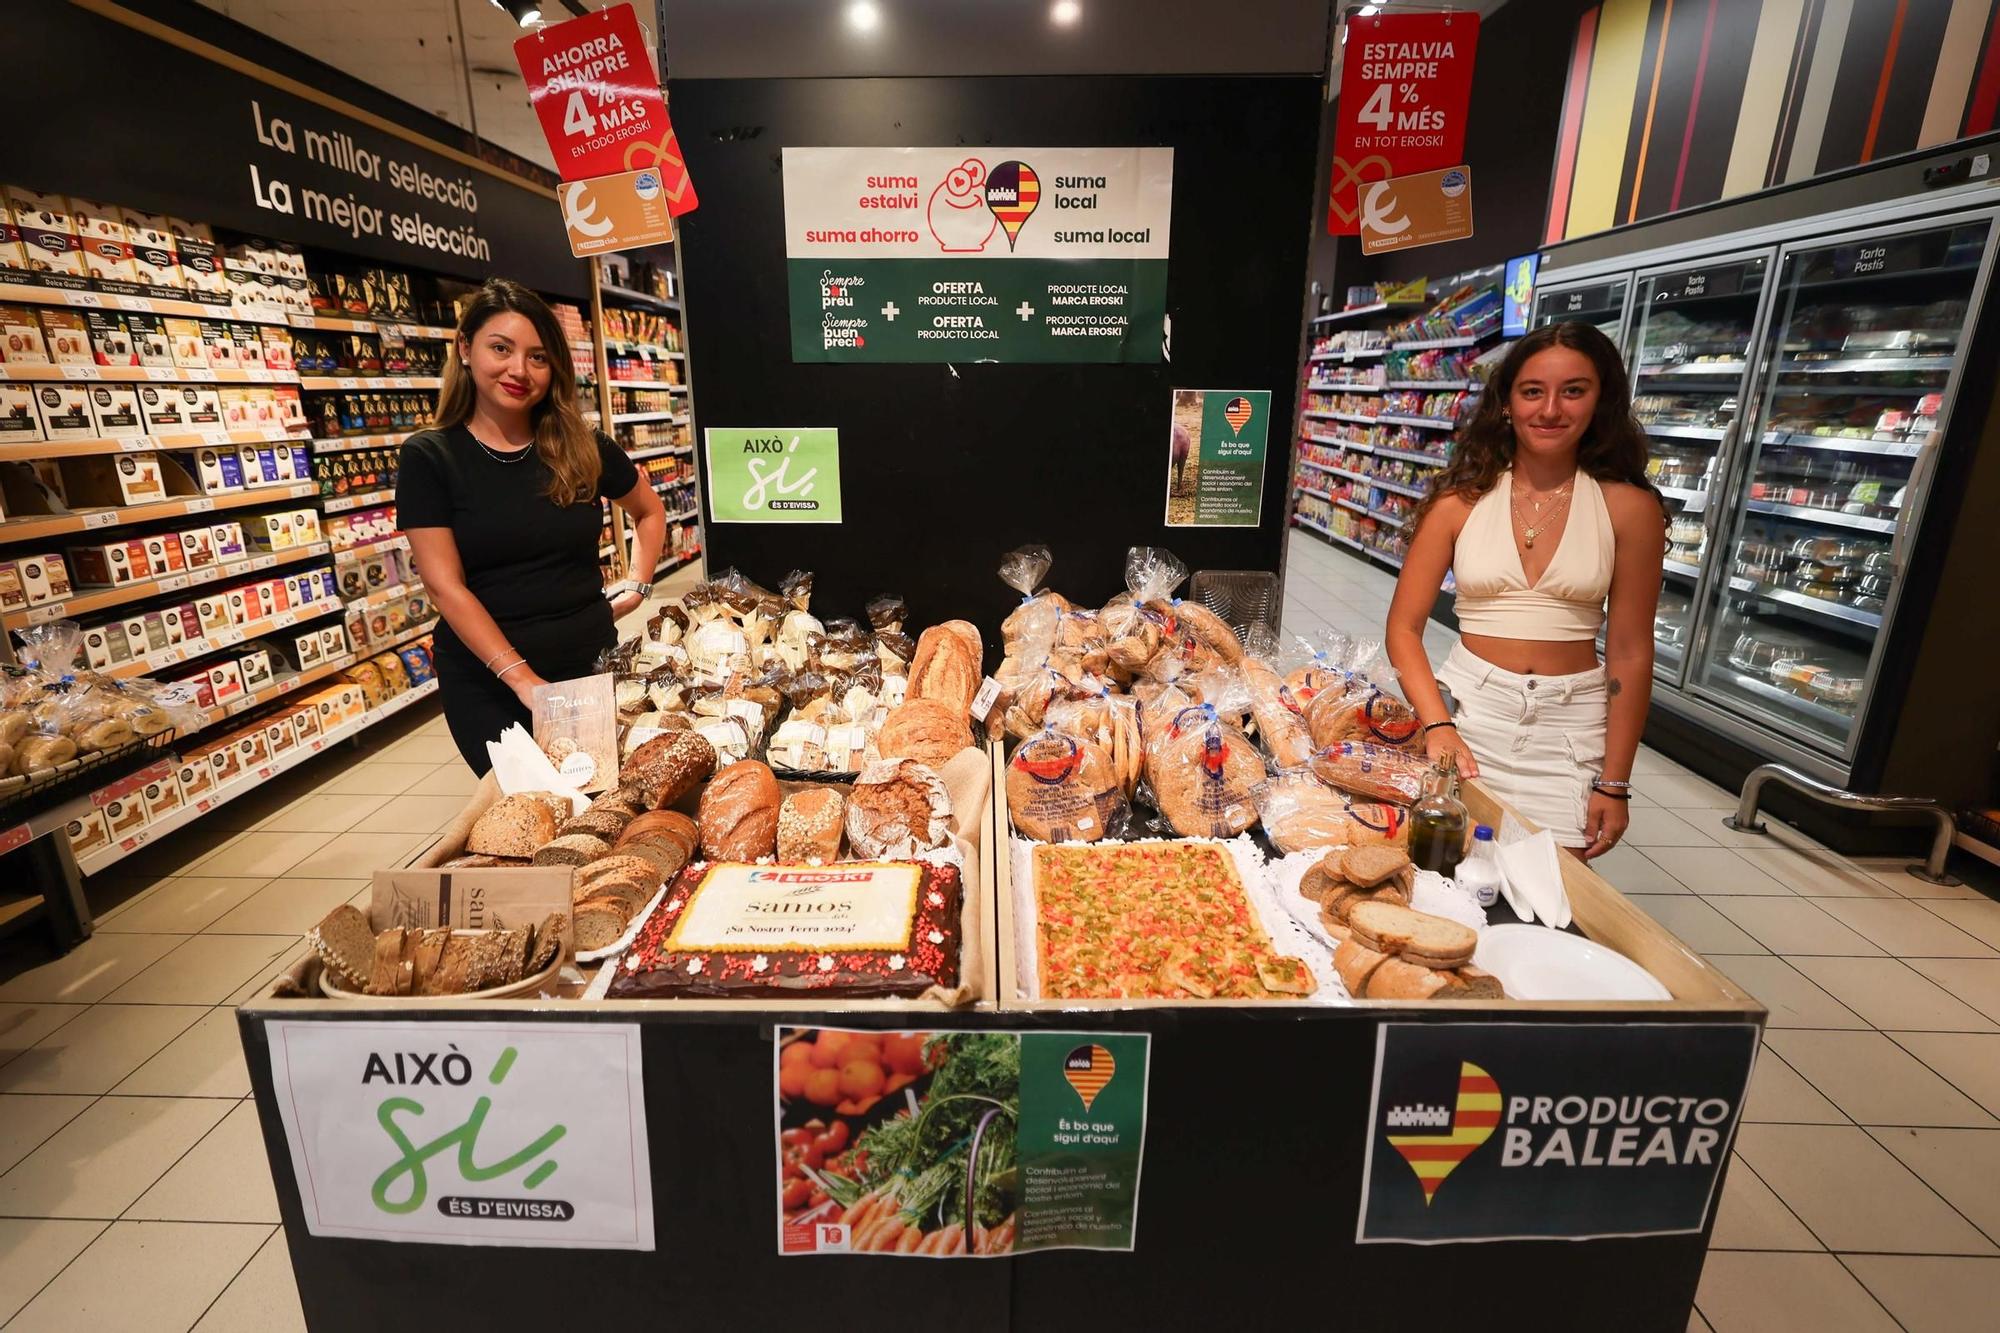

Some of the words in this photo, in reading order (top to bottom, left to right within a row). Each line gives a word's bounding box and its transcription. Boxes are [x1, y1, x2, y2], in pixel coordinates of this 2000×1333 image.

[543, 33, 624, 76] AHORRA
[1363, 42, 1455, 60] ESTALVIA
[546, 50, 630, 95] SIEMPRE
[1361, 62, 1438, 80] SEMPRE
[600, 99, 646, 132] MÁS
[1397, 105, 1446, 131] MÉS
[571, 146, 586, 158] EN
[586, 133, 615, 153] TODO
[616, 119, 652, 141] EROSKI
[1355, 137, 1371, 148] EN
[1374, 136, 1400, 148] TOT
[1400, 135, 1444, 147] EROSKI
[252, 100, 296, 154] La
[303, 129, 381, 181] millor
[388, 160, 478, 213] selecció
[867, 176, 918, 188] suma
[1055, 176, 1106, 189] suma
[859, 193, 918, 209] estalvi
[1054, 193, 1097, 209] local
[249, 164, 295, 215] La
[301, 188, 383, 239] mejor
[390, 212, 491, 262] selección
[806, 230, 857, 243] suma
[859, 227, 919, 243] ahorro
[1054, 231, 1104, 243] suma
[1108, 228, 1150, 243] local
[1860, 246, 1886, 260] Tarta
[1854, 258, 1884, 272] Pastís
[45, 278, 63, 287] Dolce
[63, 279, 82, 289] Gusto
[820, 269, 865, 288] Sempre
[102, 284, 118, 293] Dolce
[119, 285, 135, 294] Gusto
[150, 289, 165, 298] Dolce
[165, 291, 180, 299] Gusto
[932, 282, 984, 294] OFERTA
[1047, 285, 1097, 294] PRODUCTE
[1098, 285, 1128, 294] LOCAL
[822, 297, 853, 310] preu
[918, 296, 967, 305] PRODUCTE
[968, 296, 999, 306] LOCAL
[1052, 296, 1088, 305] MARCA
[1089, 296, 1123, 305] EROSKI
[821, 312, 868, 329] Siempre
[932, 316, 984, 328] OFERTA
[1045, 316, 1097, 325] PRODUCTO
[1098, 316, 1128, 325] LOCAL
[824, 326, 858, 338] buen
[917, 330, 969, 339] PRODUCTO
[970, 330, 1000, 339] LOCAL
[1051, 327, 1087, 336] MARCA
[1088, 327, 1122, 336] EROSKI
[743, 435, 783, 453] AIXÒ
[1221, 440, 1228, 448] És
[1238, 442, 1250, 450] que
[1233, 448, 1253, 456] d'aquí
[772, 500, 781, 509] ÉS
[782, 501, 817, 509] D'EIVISSA
[785, 872, 870, 883] EROSKI
[745, 901, 852, 913] samos
[748, 925, 784, 933] Nostra
[790, 925, 819, 933] Terra
[361, 1043, 473, 1087] AIXÒ
[1506, 1095, 1731, 1126] PRODUCTO
[1059, 1118, 1071, 1131] És
[1073, 1121, 1089, 1132] bo
[1092, 1122, 1115, 1133] que
[1053, 1133, 1080, 1145] sigui
[1082, 1133, 1120, 1145] d'aquí
[1500, 1127, 1721, 1168] BALEAR
[449, 1198, 473, 1215] ÉS
[478, 1201, 566, 1219] D'EIVISSA
